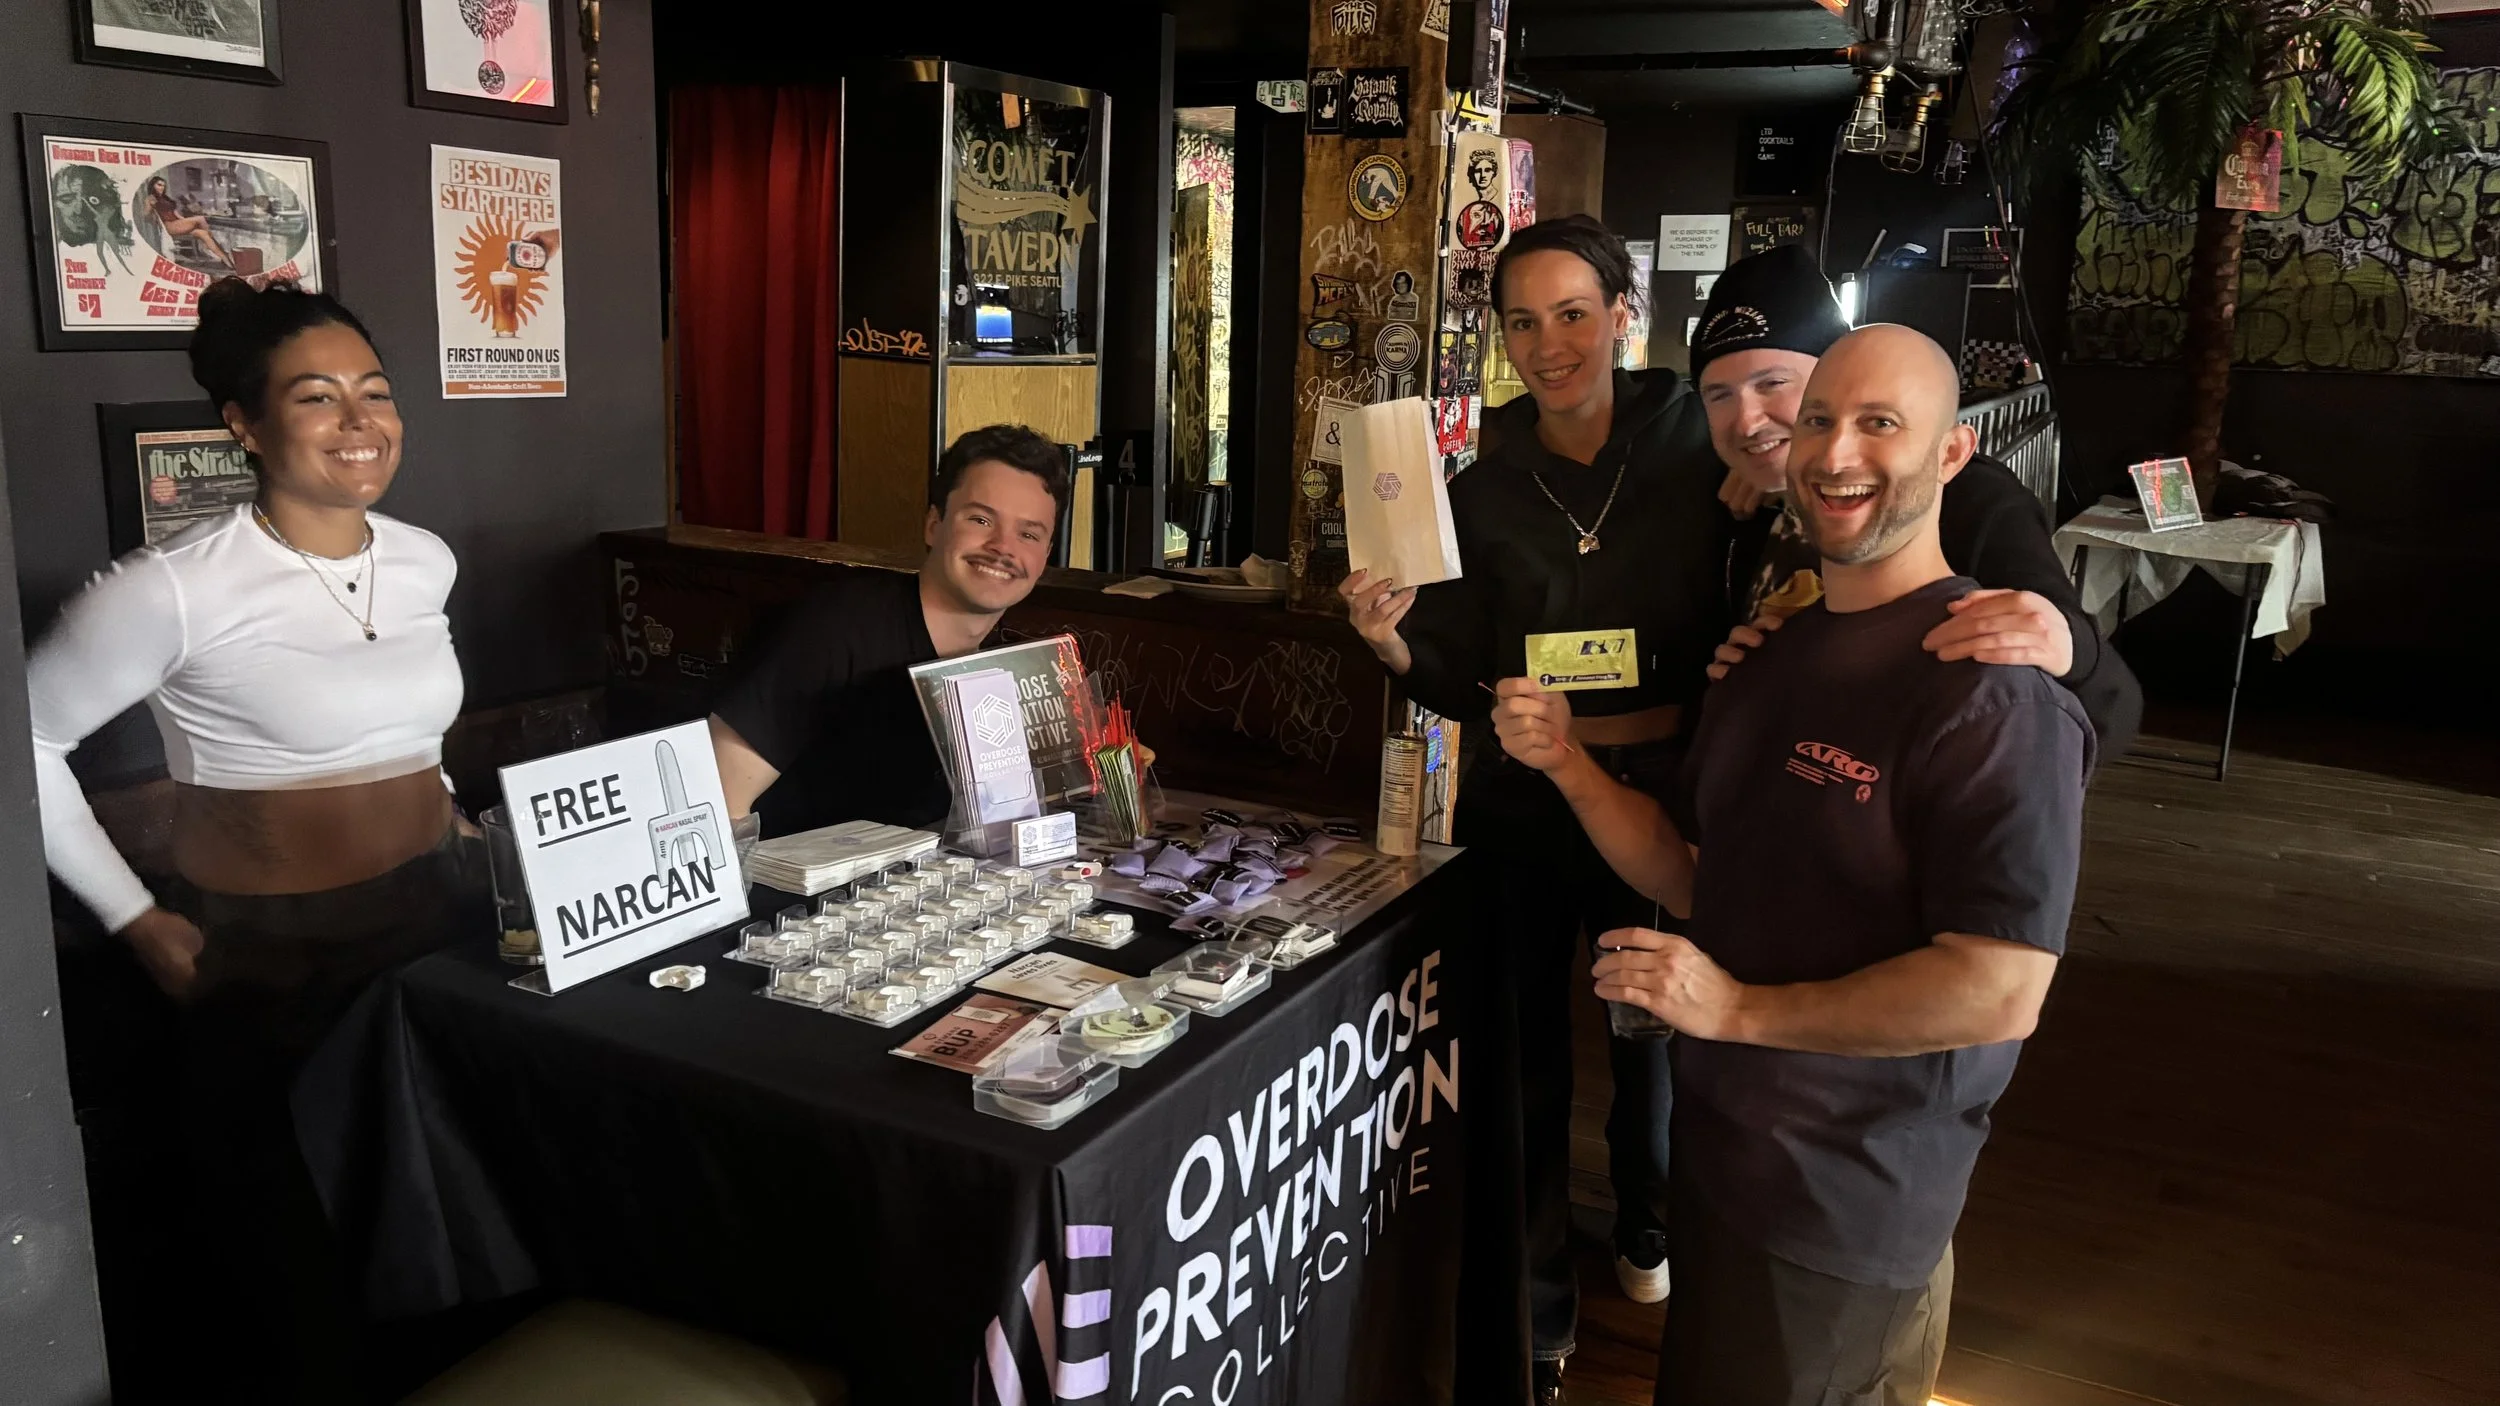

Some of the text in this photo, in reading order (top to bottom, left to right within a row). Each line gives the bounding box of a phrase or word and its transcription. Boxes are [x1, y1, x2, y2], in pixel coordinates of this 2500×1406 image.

[1346, 2, 1363, 10] THE
[1348, 75, 1397, 102] Satanik
[1355, 97, 1403, 127] Royalty
[967, 139, 1075, 188] COMET
[451, 159, 551, 197] BEST DAYS
[441, 184, 554, 222] START HERE
[1746, 222, 1772, 236] FULL
[965, 228, 1080, 273] TAVERN
[973, 273, 993, 286] 922
[1005, 274, 1028, 287] PIKE
[1030, 276, 1066, 288] SEATTLE
[78, 294, 101, 318] $7
[447, 348, 560, 363] FIRST ROUND ON US
[189, 447, 251, 478] Stran
[1026, 720, 1072, 751] CTIVE
[979, 754, 1027, 773] PREVENTION
[980, 745, 1022, 762] OVERDOSE
[530, 773, 627, 837] FREE
[660, 813, 707, 832] NARCAN NASAL SPRAY
[556, 856, 716, 947] NARCAN
[1007, 958, 1042, 975] Narcan
[1011, 958, 1058, 980] saves lives
[937, 1028, 978, 1056] BUP
[1166, 950, 1441, 1242] OVERDOSE
[1131, 1038, 1459, 1402] PREVENTION
